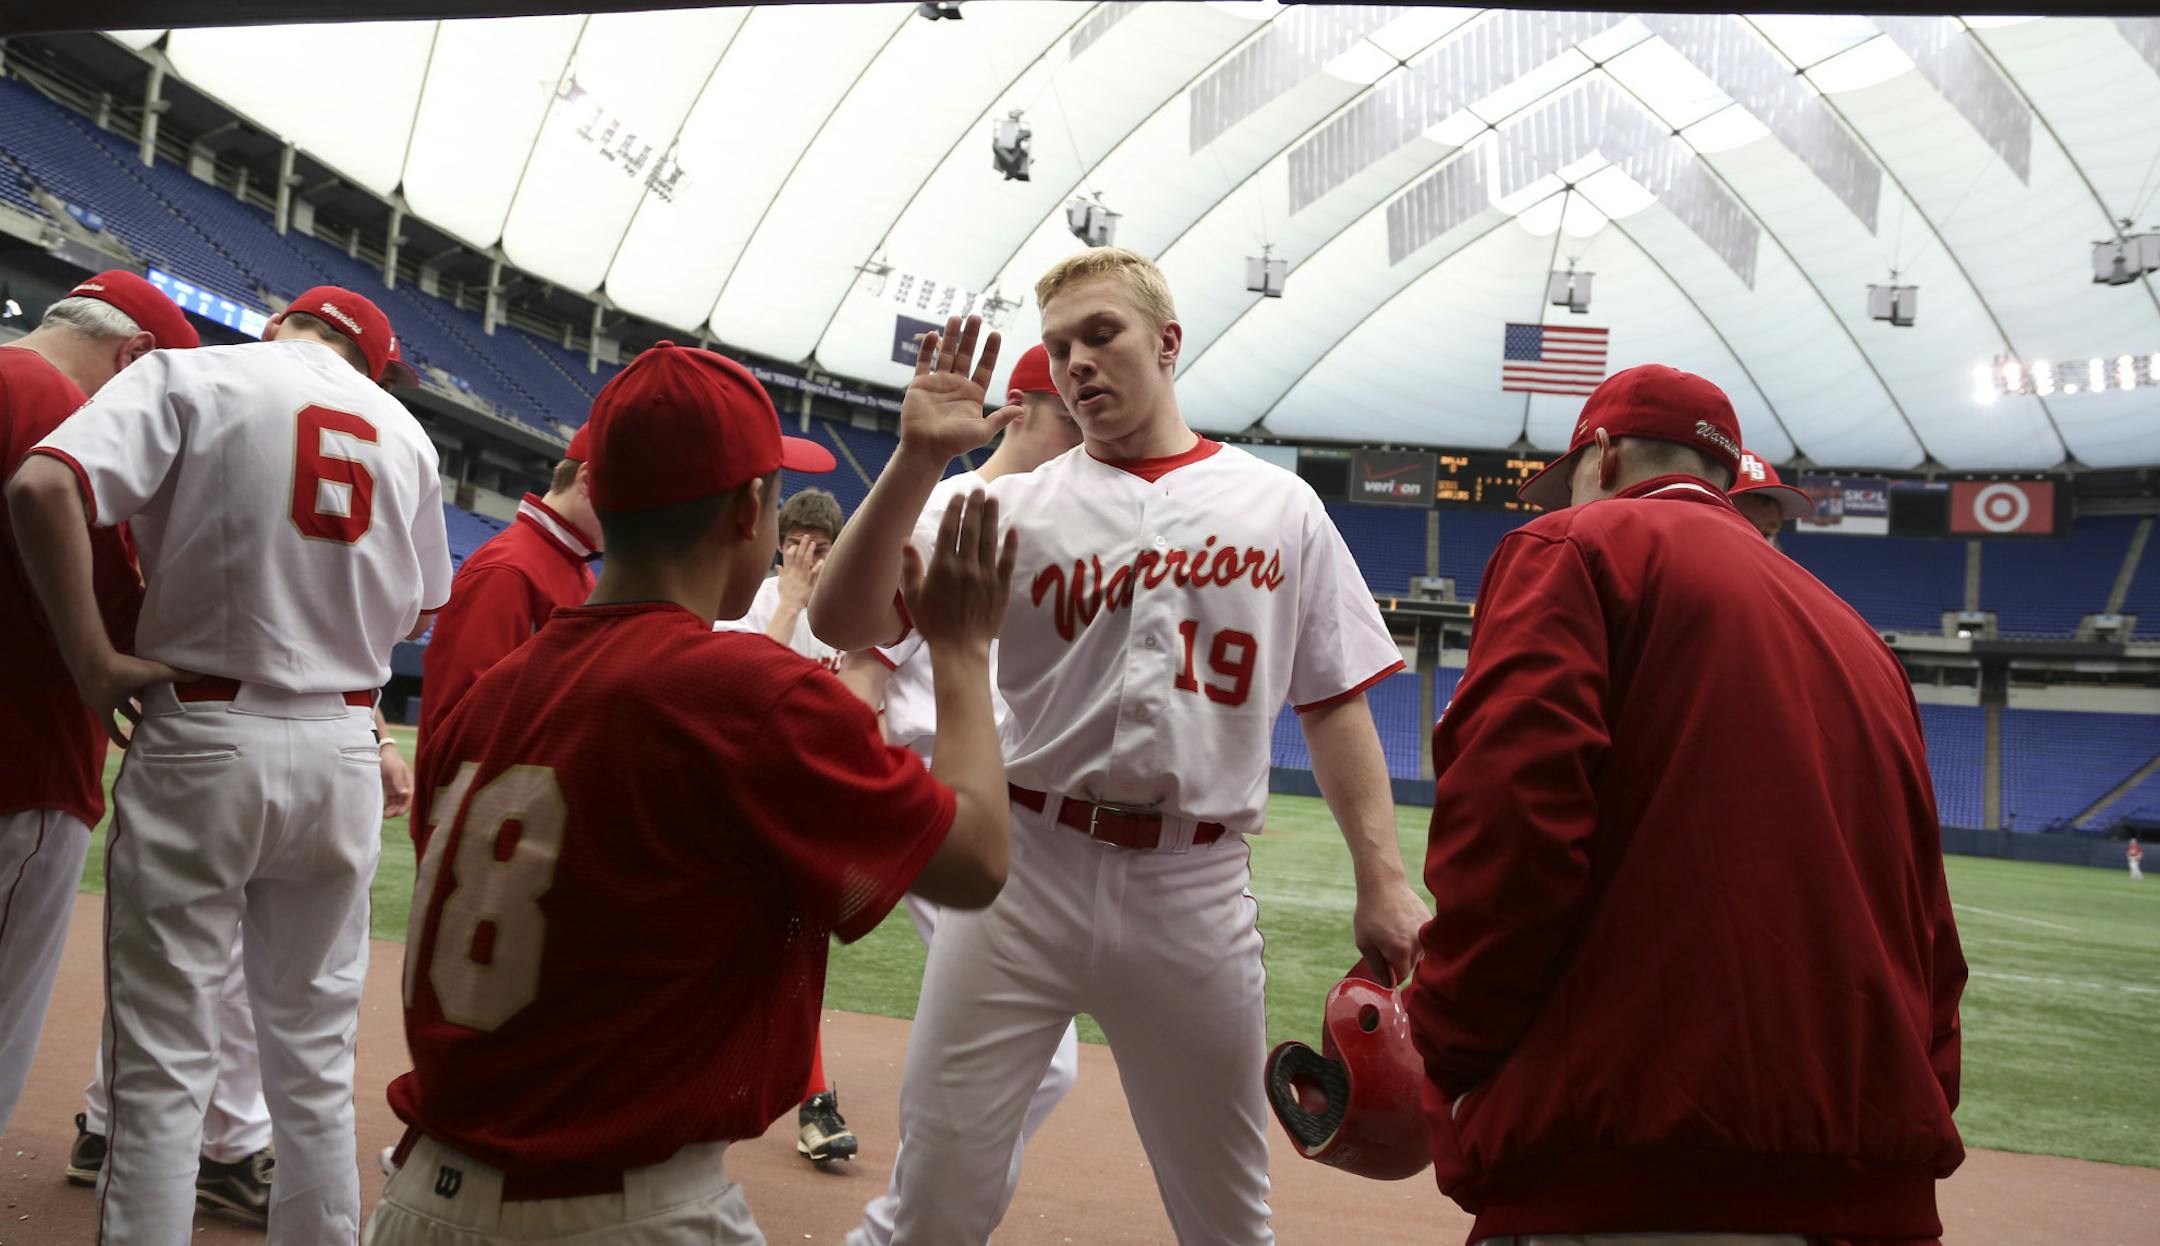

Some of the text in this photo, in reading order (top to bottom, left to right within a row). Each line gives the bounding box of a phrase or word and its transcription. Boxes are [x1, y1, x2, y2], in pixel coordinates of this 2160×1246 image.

[321, 302, 362, 334] Warriors
[288, 401, 381, 547] 6
[1364, 480, 1421, 497] verizon
[1031, 534, 1285, 643] Warriors
[1173, 618, 1258, 707] 19
[403, 760, 569, 1032] 18
